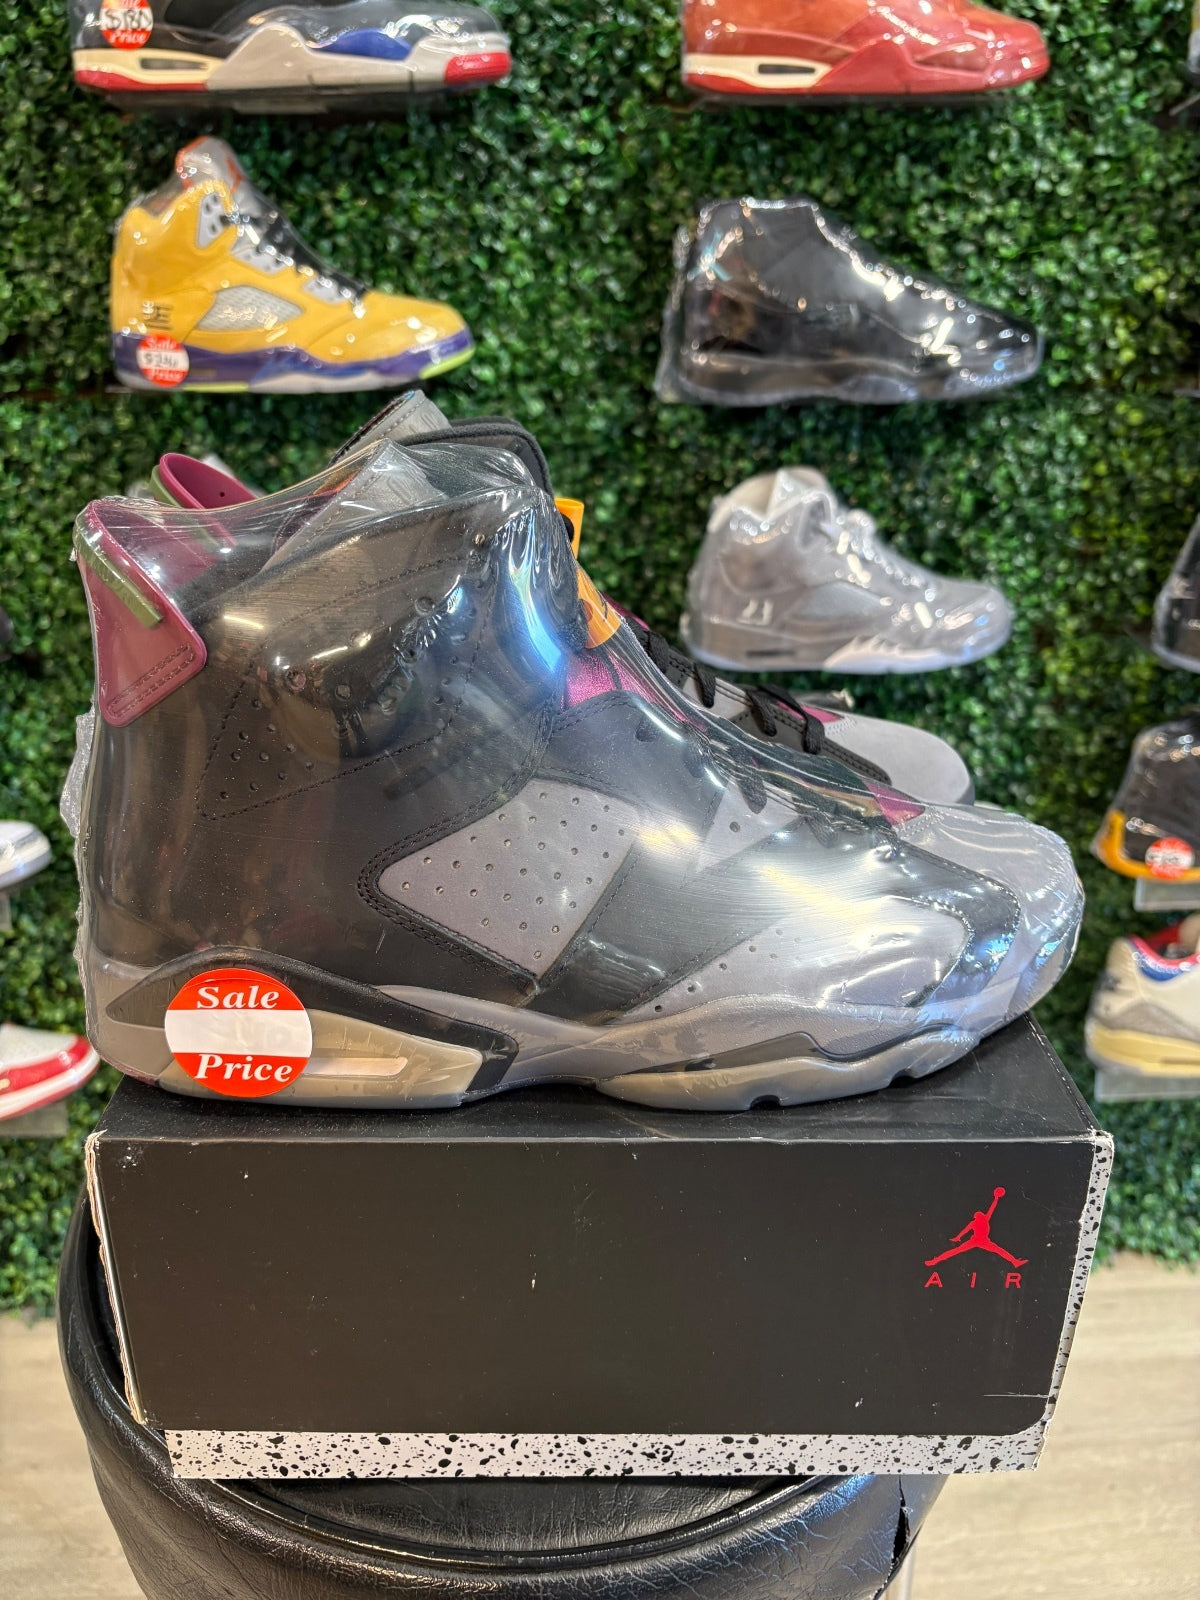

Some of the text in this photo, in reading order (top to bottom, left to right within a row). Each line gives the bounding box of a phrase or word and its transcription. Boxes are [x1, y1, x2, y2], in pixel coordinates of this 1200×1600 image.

[109, 31, 147, 44] Price
[147, 336, 176, 349] Sale
[149, 368, 183, 381] Price
[196, 985, 280, 1009] Sale
[194, 1053, 293, 1083] Price
[924, 1271, 1022, 1289] AIR
